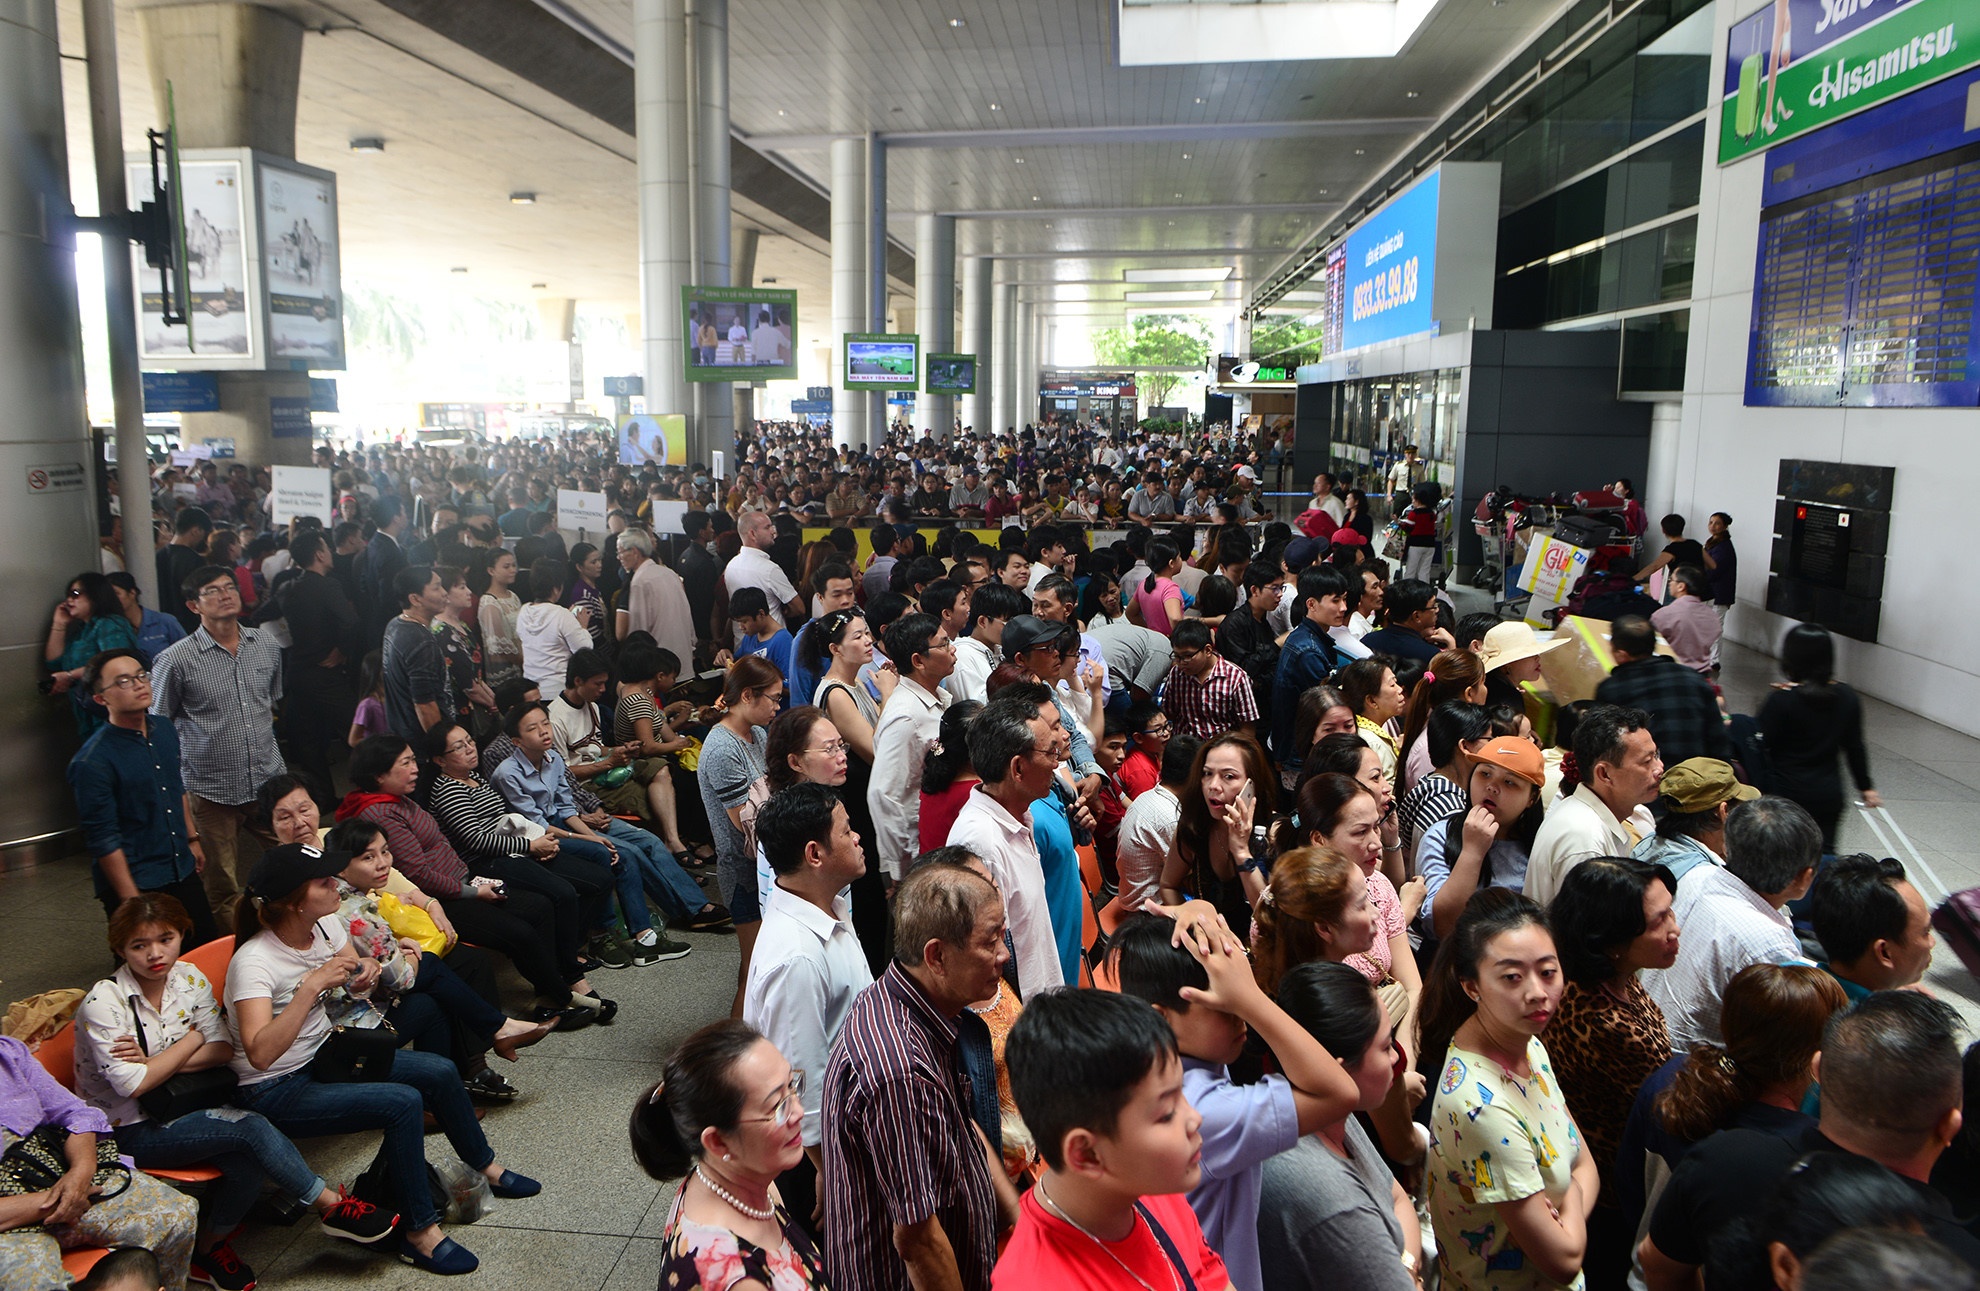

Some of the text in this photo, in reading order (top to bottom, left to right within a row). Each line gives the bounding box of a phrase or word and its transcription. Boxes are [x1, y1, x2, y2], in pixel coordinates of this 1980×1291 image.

[1808, 22, 1954, 108] Hisamitsu
[1353, 255, 1419, 322] 0933.33.99.88
[617, 379, 628, 394] 9
[812, 388, 826, 398] 10
[1096, 386, 1120, 396] KING
